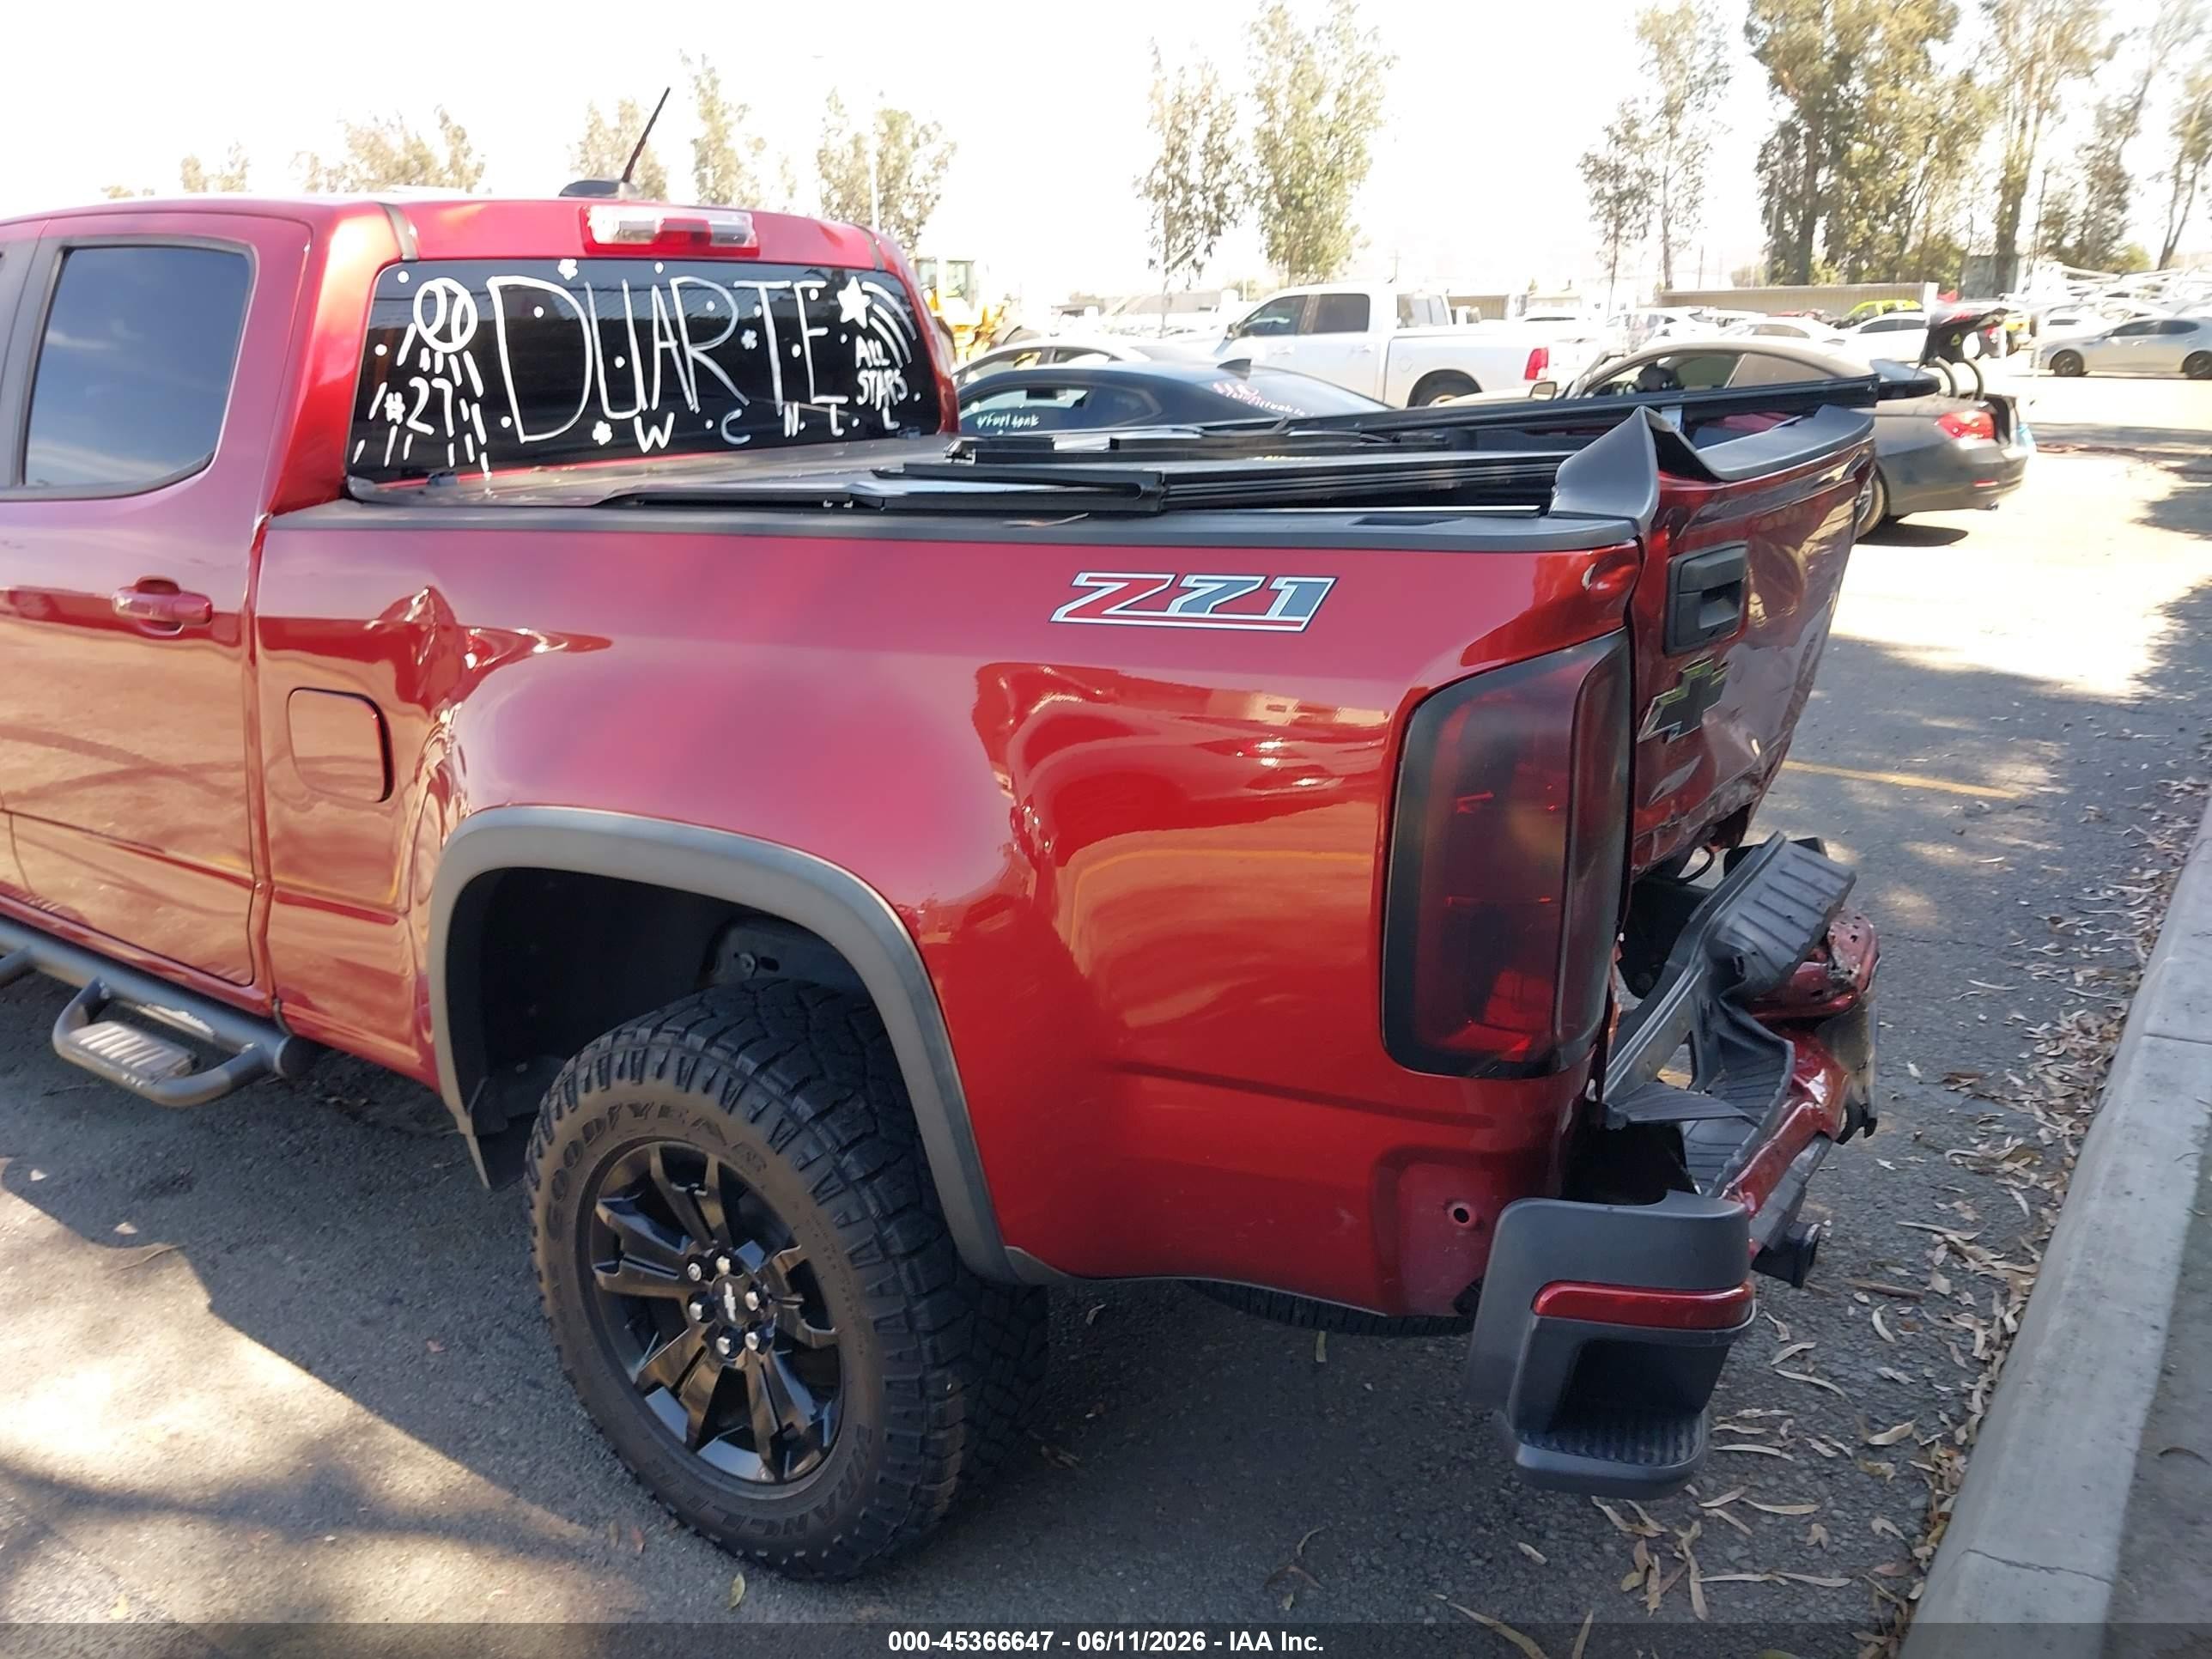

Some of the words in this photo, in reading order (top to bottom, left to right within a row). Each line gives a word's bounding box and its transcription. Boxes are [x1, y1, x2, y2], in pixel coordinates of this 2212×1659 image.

[488, 275, 848, 443] DUARTE
[855, 335, 891, 369] ALL
[383, 376, 455, 439] #27
[855, 369, 908, 412] STARS
[1049, 570, 1339, 633] Z71
